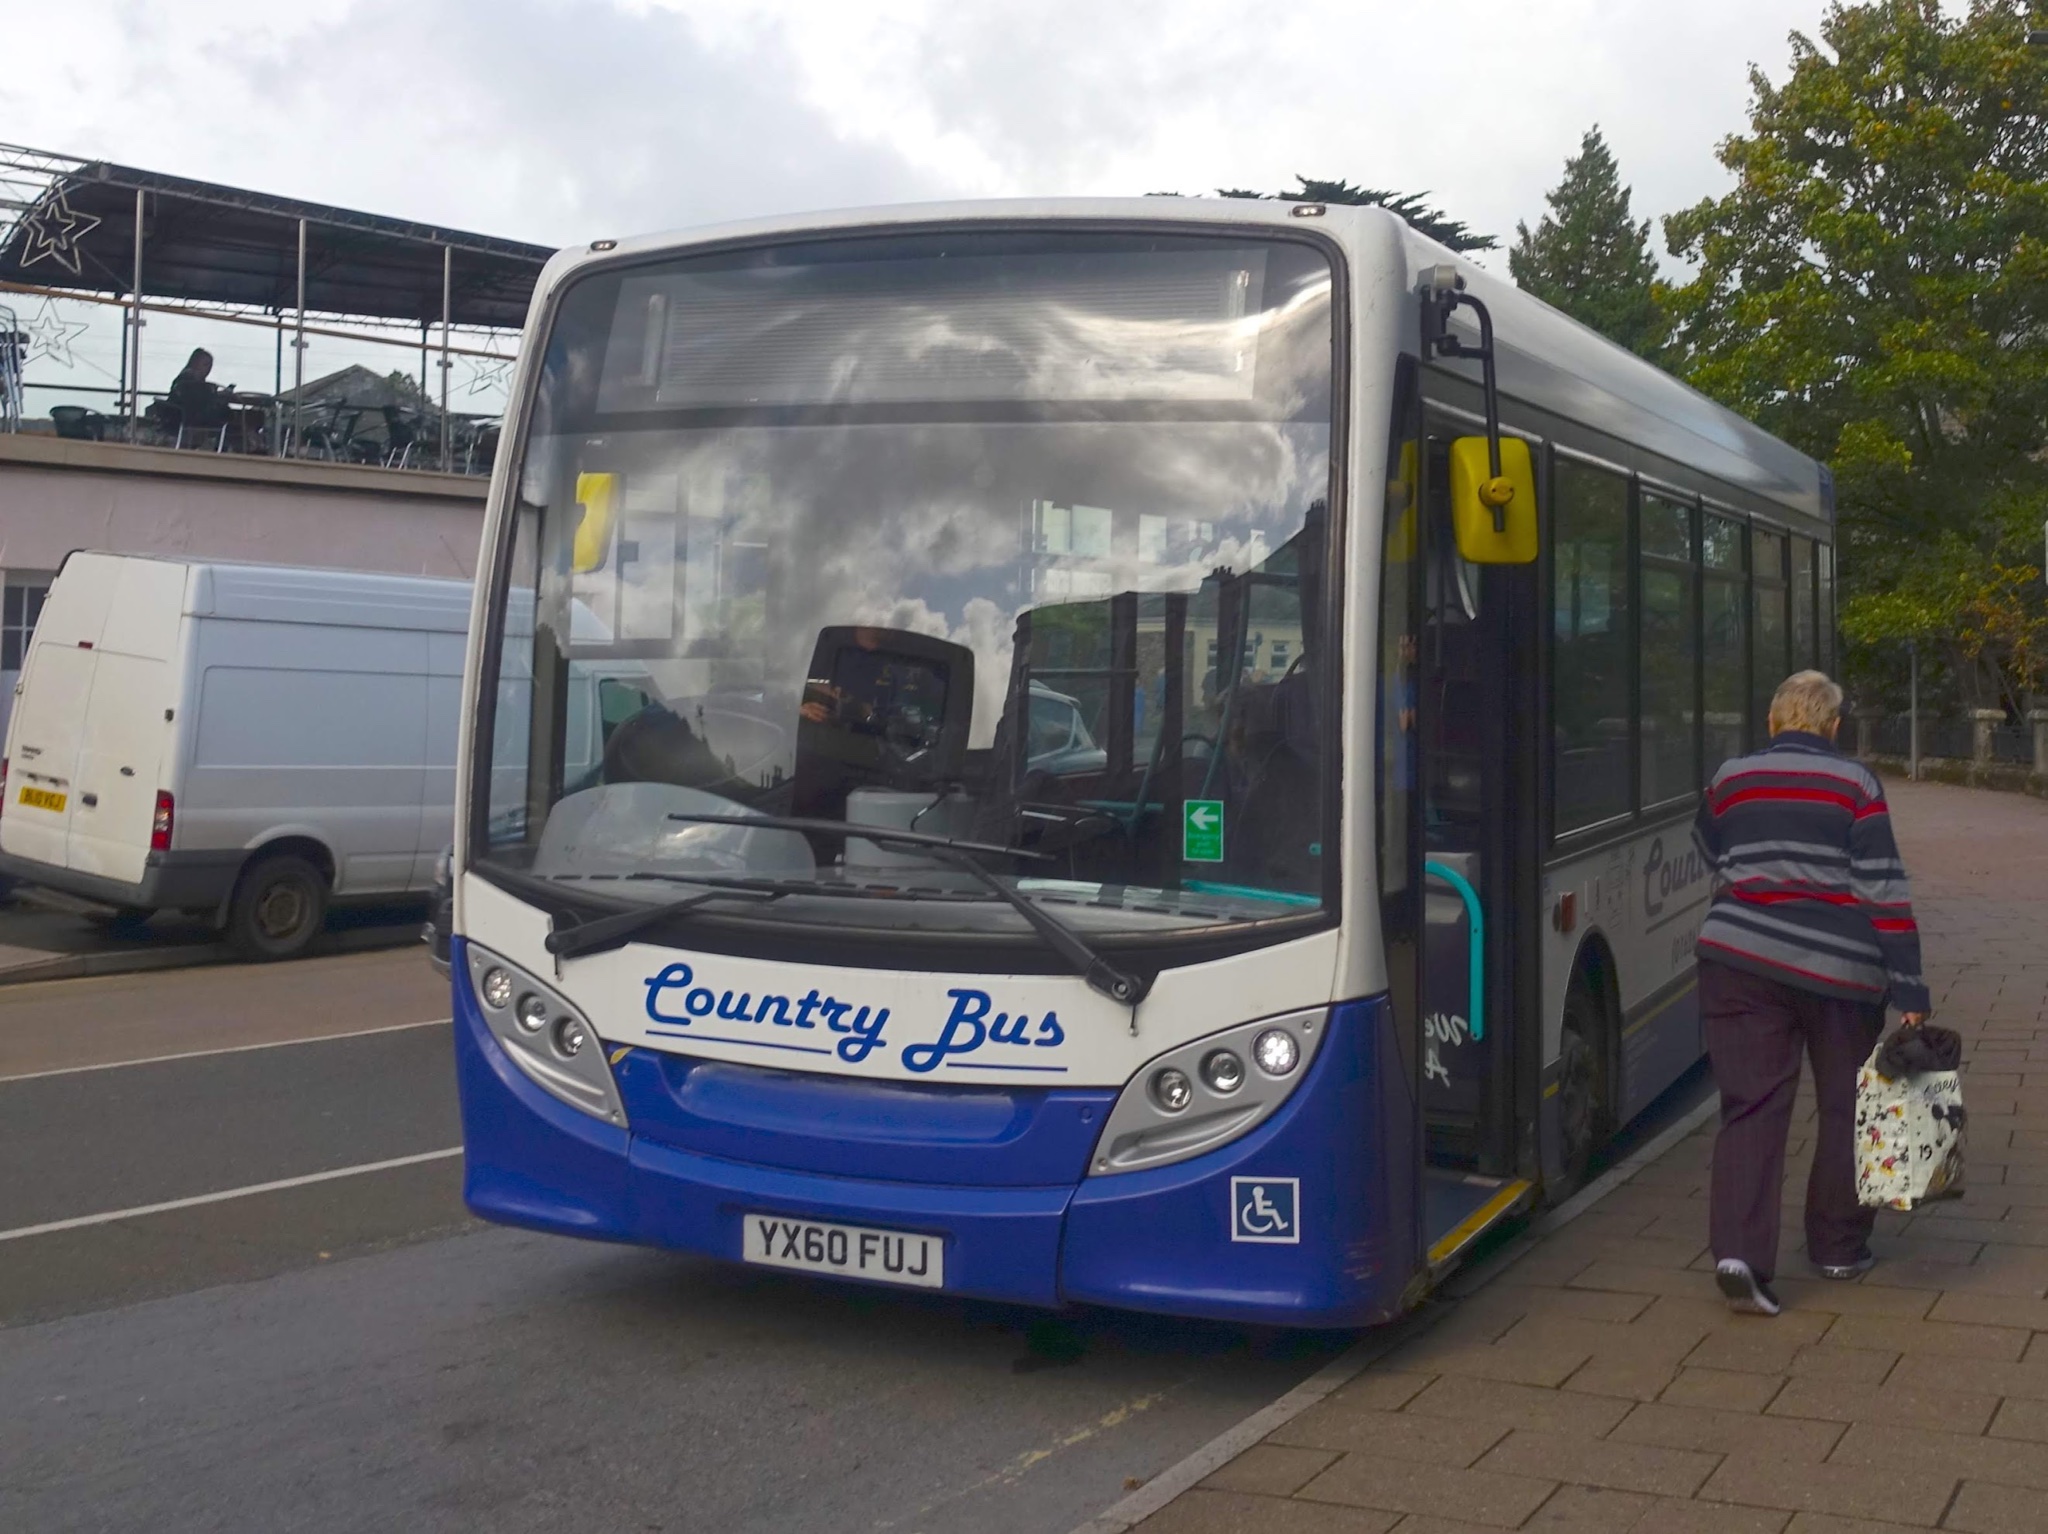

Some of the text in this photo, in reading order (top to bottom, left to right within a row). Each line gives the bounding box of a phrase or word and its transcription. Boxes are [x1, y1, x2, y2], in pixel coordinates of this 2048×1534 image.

[644, 962, 1065, 1073] Country Bus
[759, 1220, 928, 1277] YX60 FUJ
